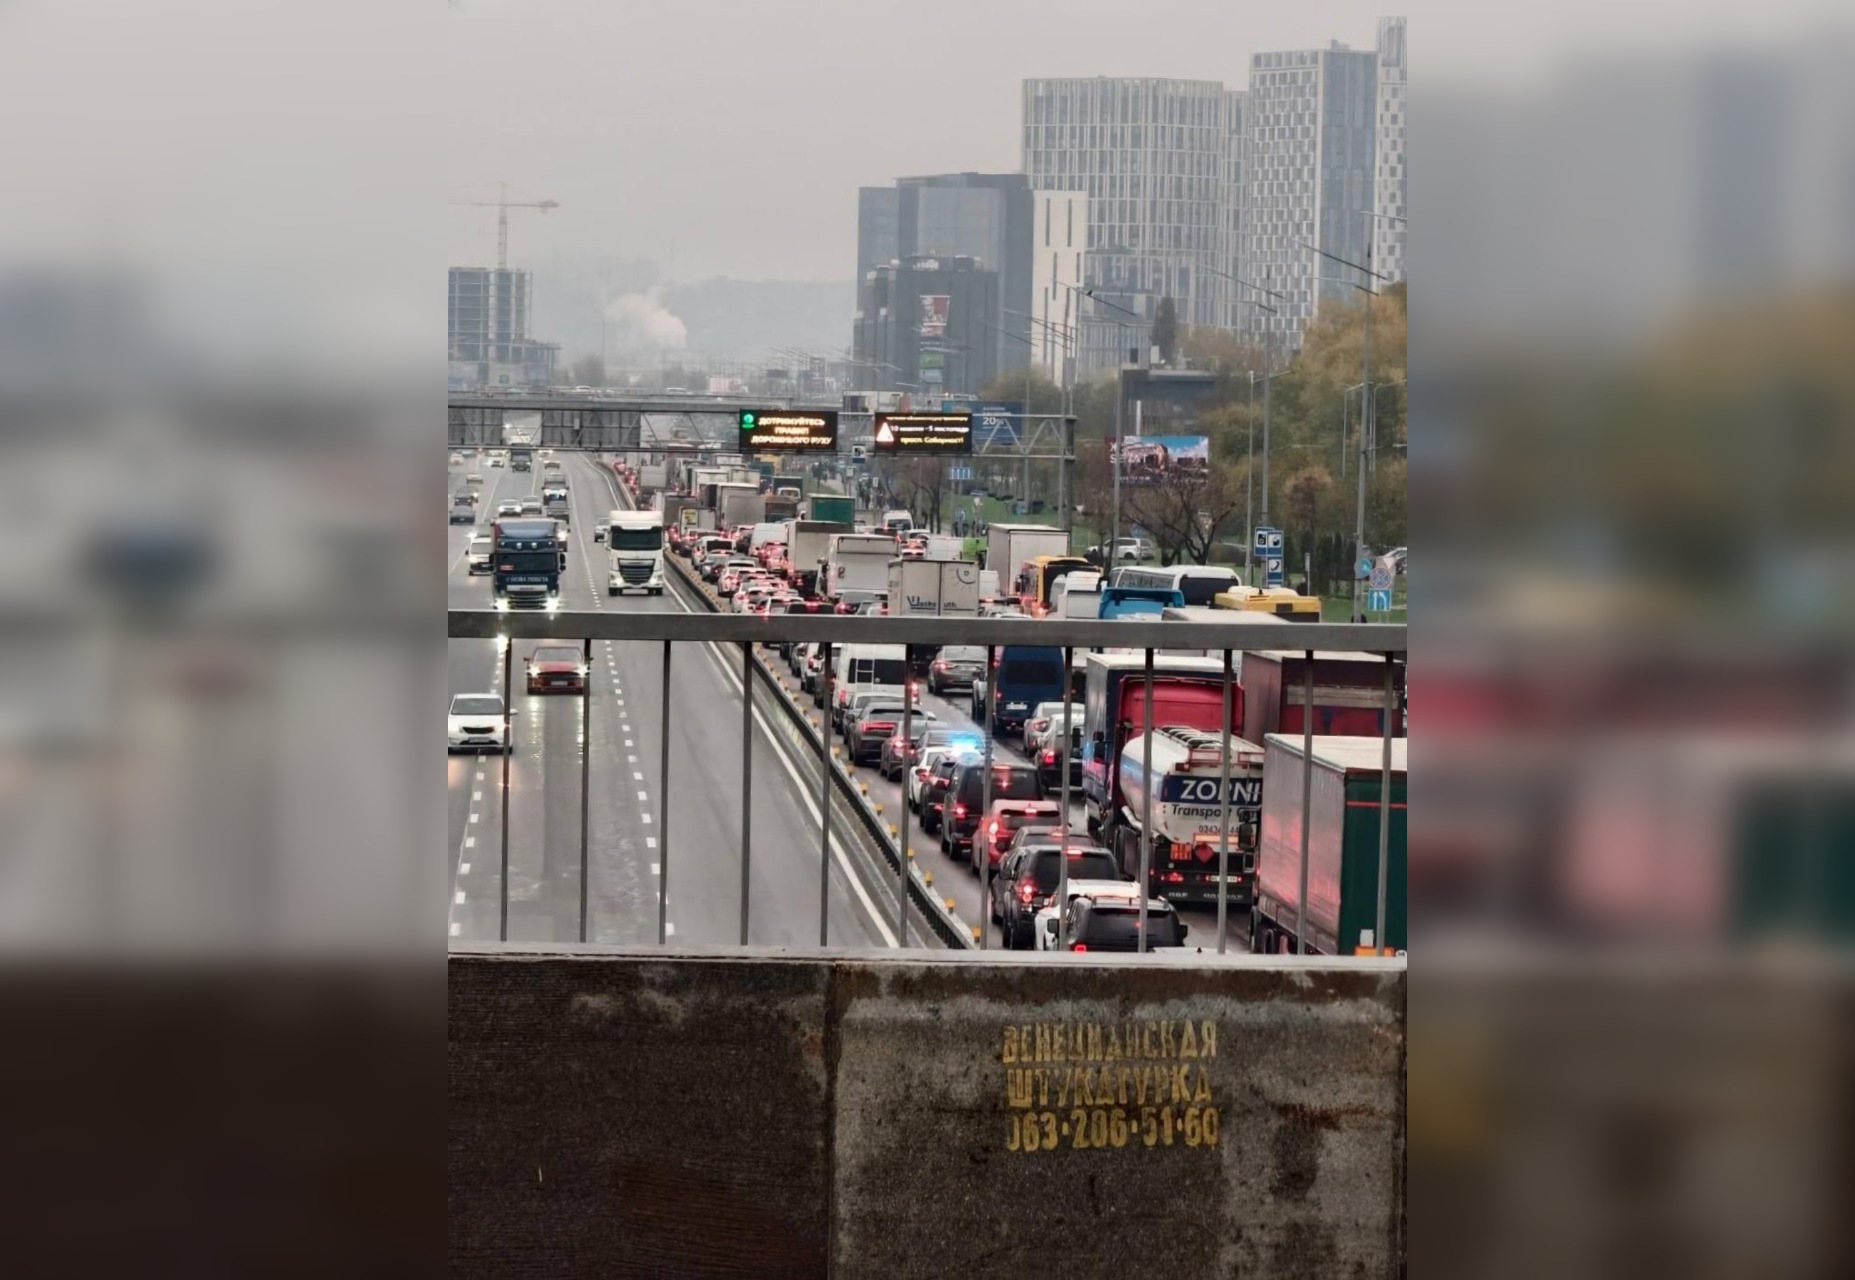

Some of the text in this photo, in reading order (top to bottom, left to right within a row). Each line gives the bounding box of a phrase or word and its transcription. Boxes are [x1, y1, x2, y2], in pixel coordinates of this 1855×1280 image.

[1171, 803, 1233, 820] Transpot
[1002, 1019, 1217, 1064] ВЕНЕЦИАНСКАЯ
[1007, 1062, 1212, 1108] ШТУКАТУРКА
